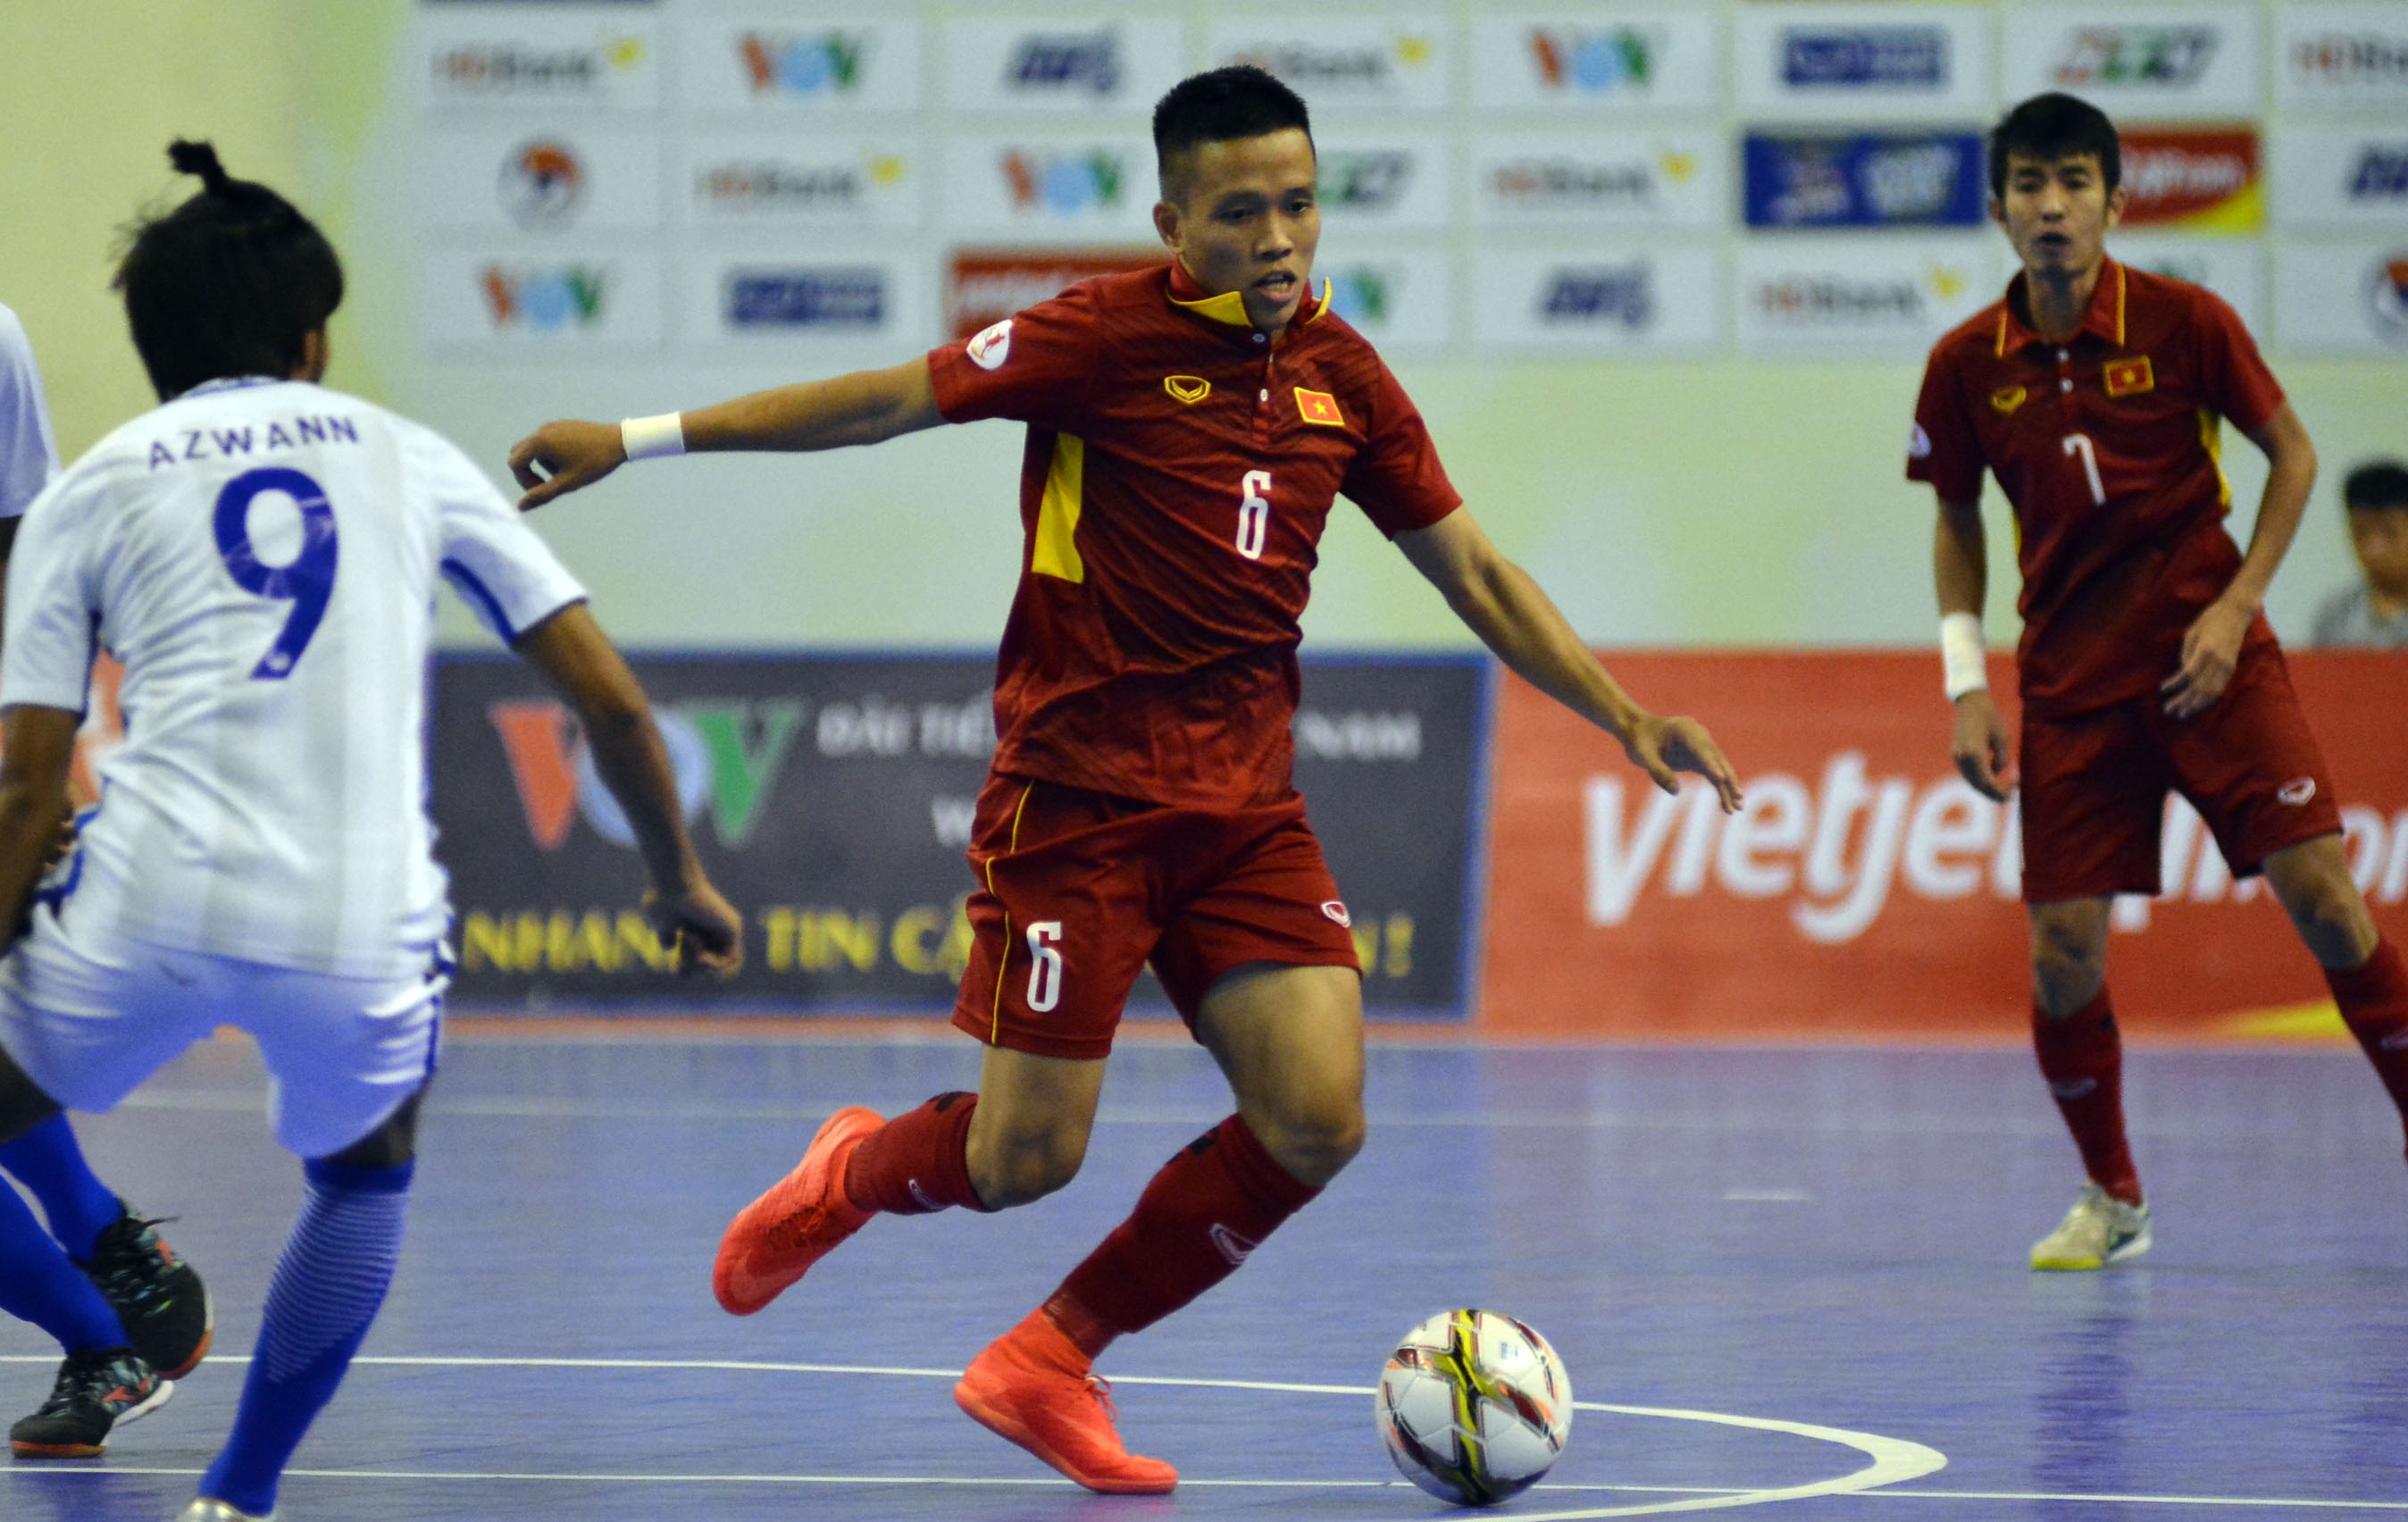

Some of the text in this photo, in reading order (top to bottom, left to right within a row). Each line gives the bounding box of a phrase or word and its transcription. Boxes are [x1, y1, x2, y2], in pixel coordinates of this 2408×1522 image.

[147, 415, 359, 470] AZWANN
[2061, 432, 2106, 506] 7
[1236, 470, 1272, 560] 6
[213, 465, 339, 681] 9
[762, 907, 880, 974] TIN
[1026, 920, 1063, 1013] 6
